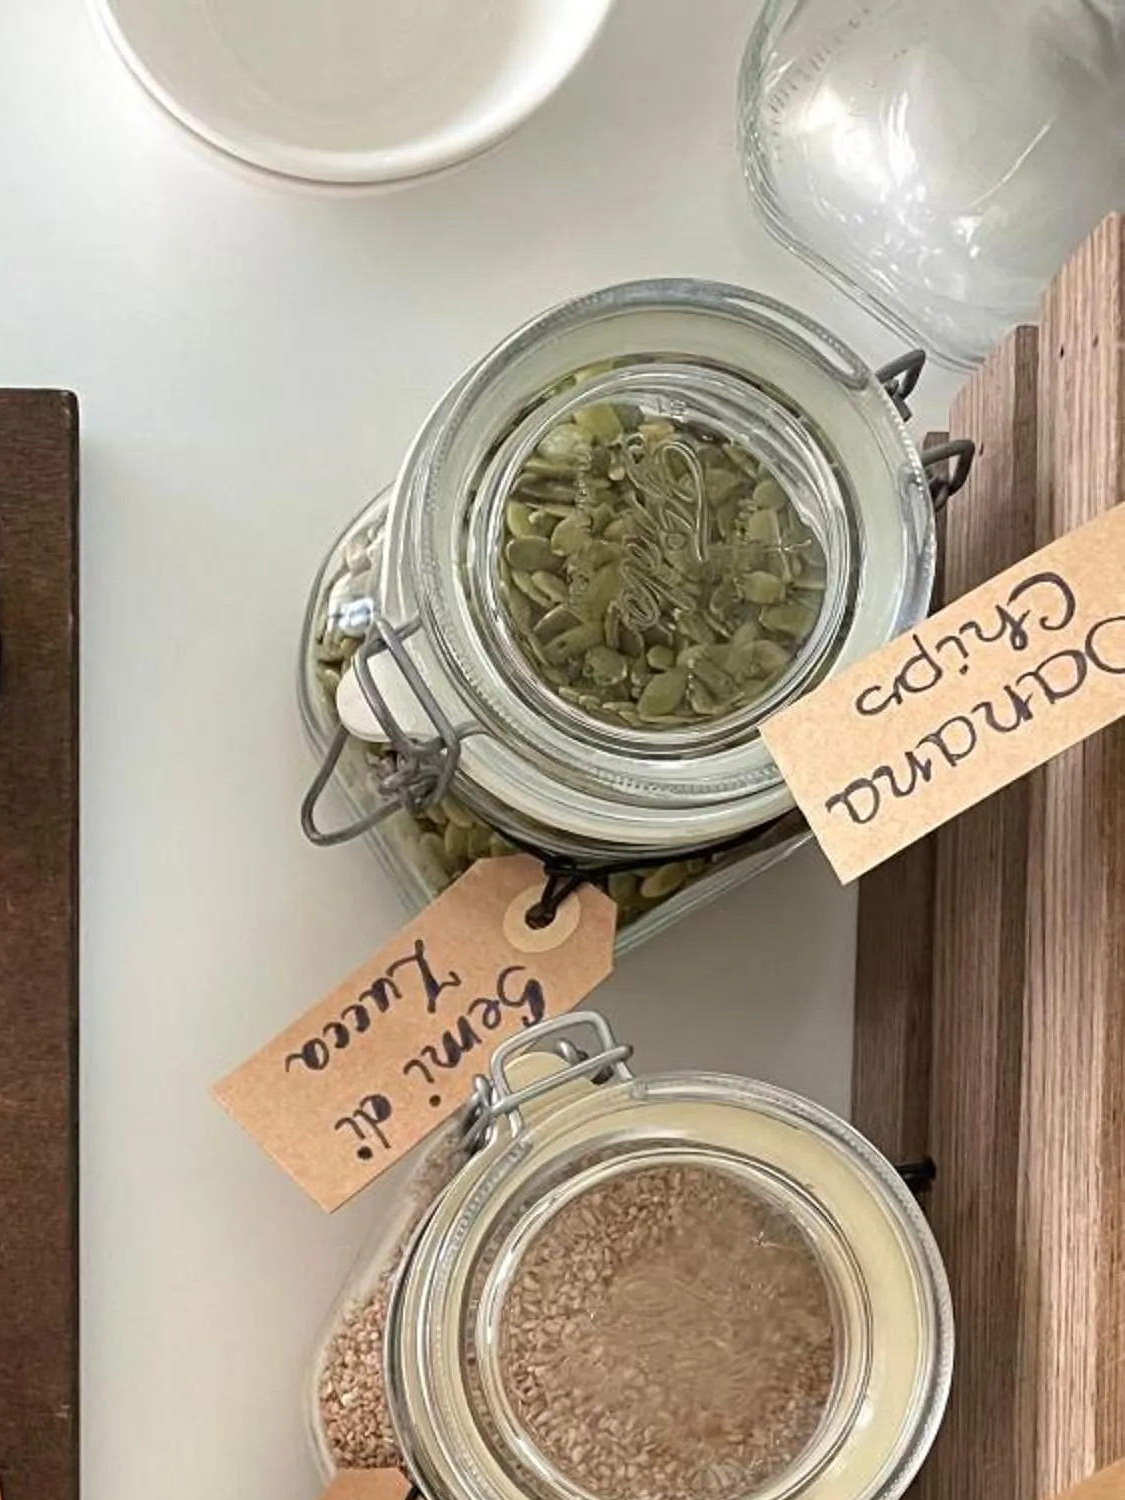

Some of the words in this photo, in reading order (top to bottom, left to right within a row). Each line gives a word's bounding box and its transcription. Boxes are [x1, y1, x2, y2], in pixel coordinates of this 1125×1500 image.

[855, 571, 1076, 716] Chips
[285, 939, 461, 1073] Zucca
[403, 965, 545, 1107] Semi
[334, 1094, 392, 1160] di
